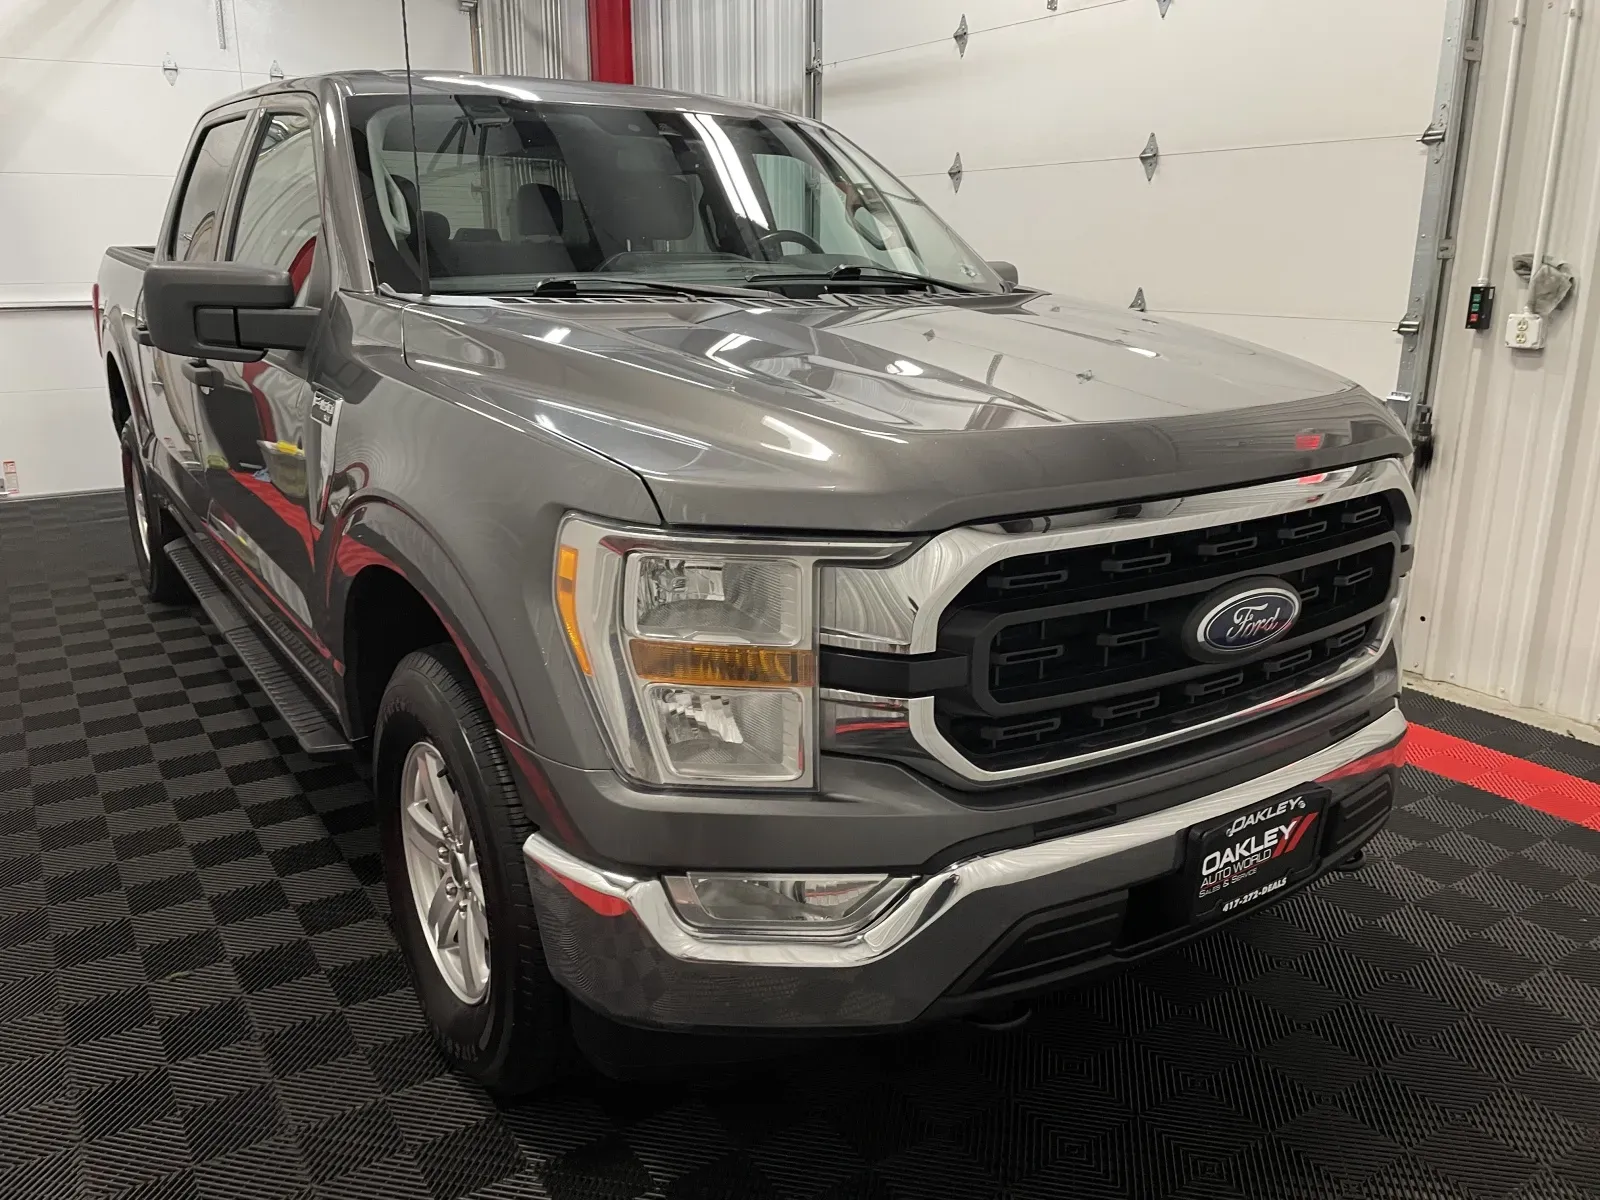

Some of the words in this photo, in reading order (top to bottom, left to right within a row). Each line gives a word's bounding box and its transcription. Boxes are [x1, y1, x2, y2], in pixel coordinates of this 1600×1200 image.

[1226, 602, 1281, 642] Ford
[1231, 796, 1302, 833] OAKLEY
[1200, 866, 1232, 888] AUTO
[1232, 848, 1272, 873] WORLD
[1202, 821, 1297, 875] OAKLEY
[1222, 876, 1287, 912] 417-272-DEALS
